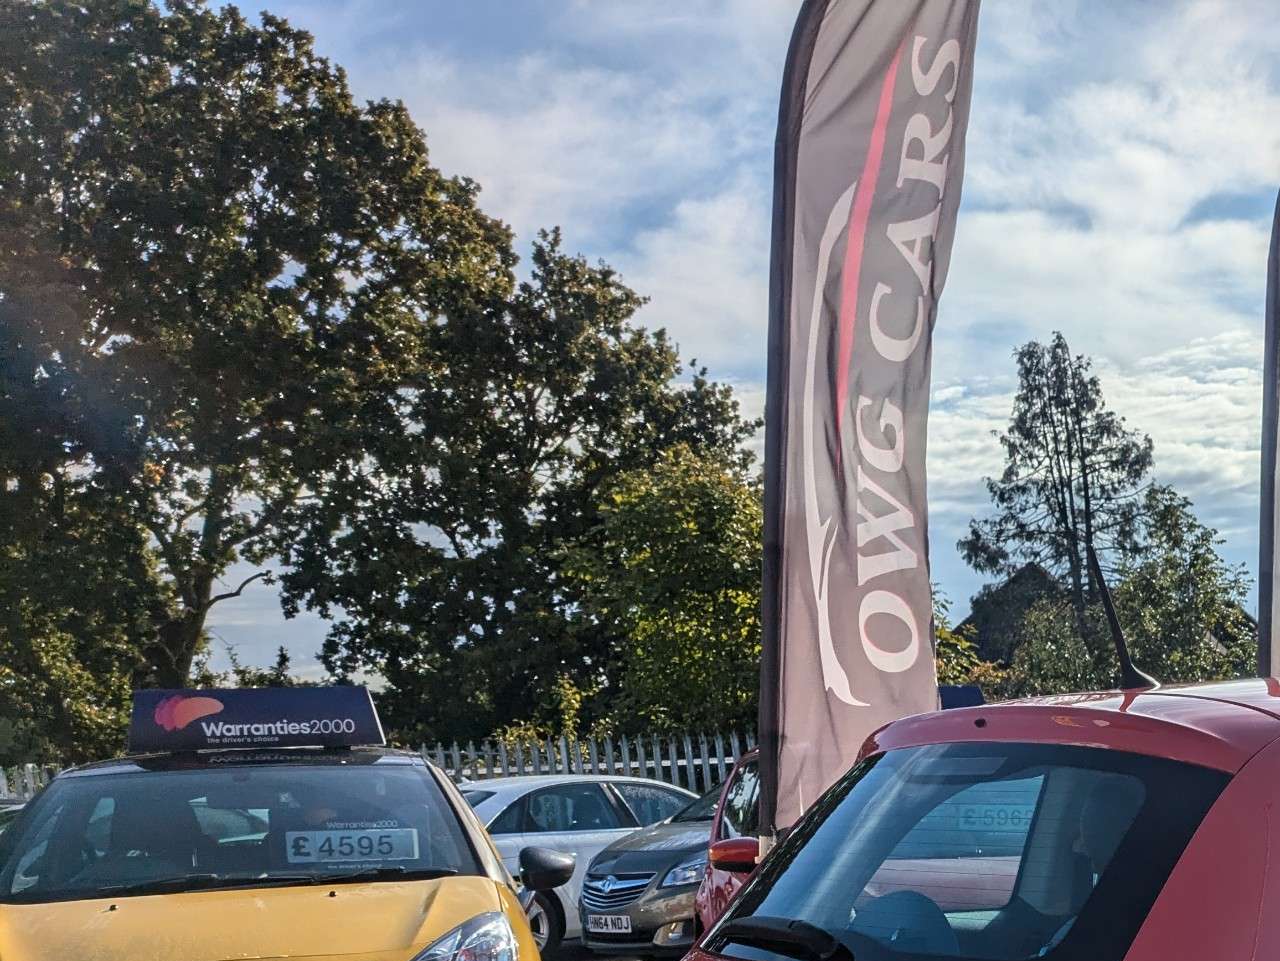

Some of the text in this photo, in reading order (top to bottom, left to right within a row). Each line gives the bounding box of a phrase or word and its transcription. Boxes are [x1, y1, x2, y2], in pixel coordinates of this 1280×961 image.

[856, 35, 961, 673] OWG CARS
[201, 718, 356, 738] Warranties2000
[206, 735, 280, 744] the driver's choice
[318, 834, 394, 857] 4595
[610, 916, 630, 930] NDJ
